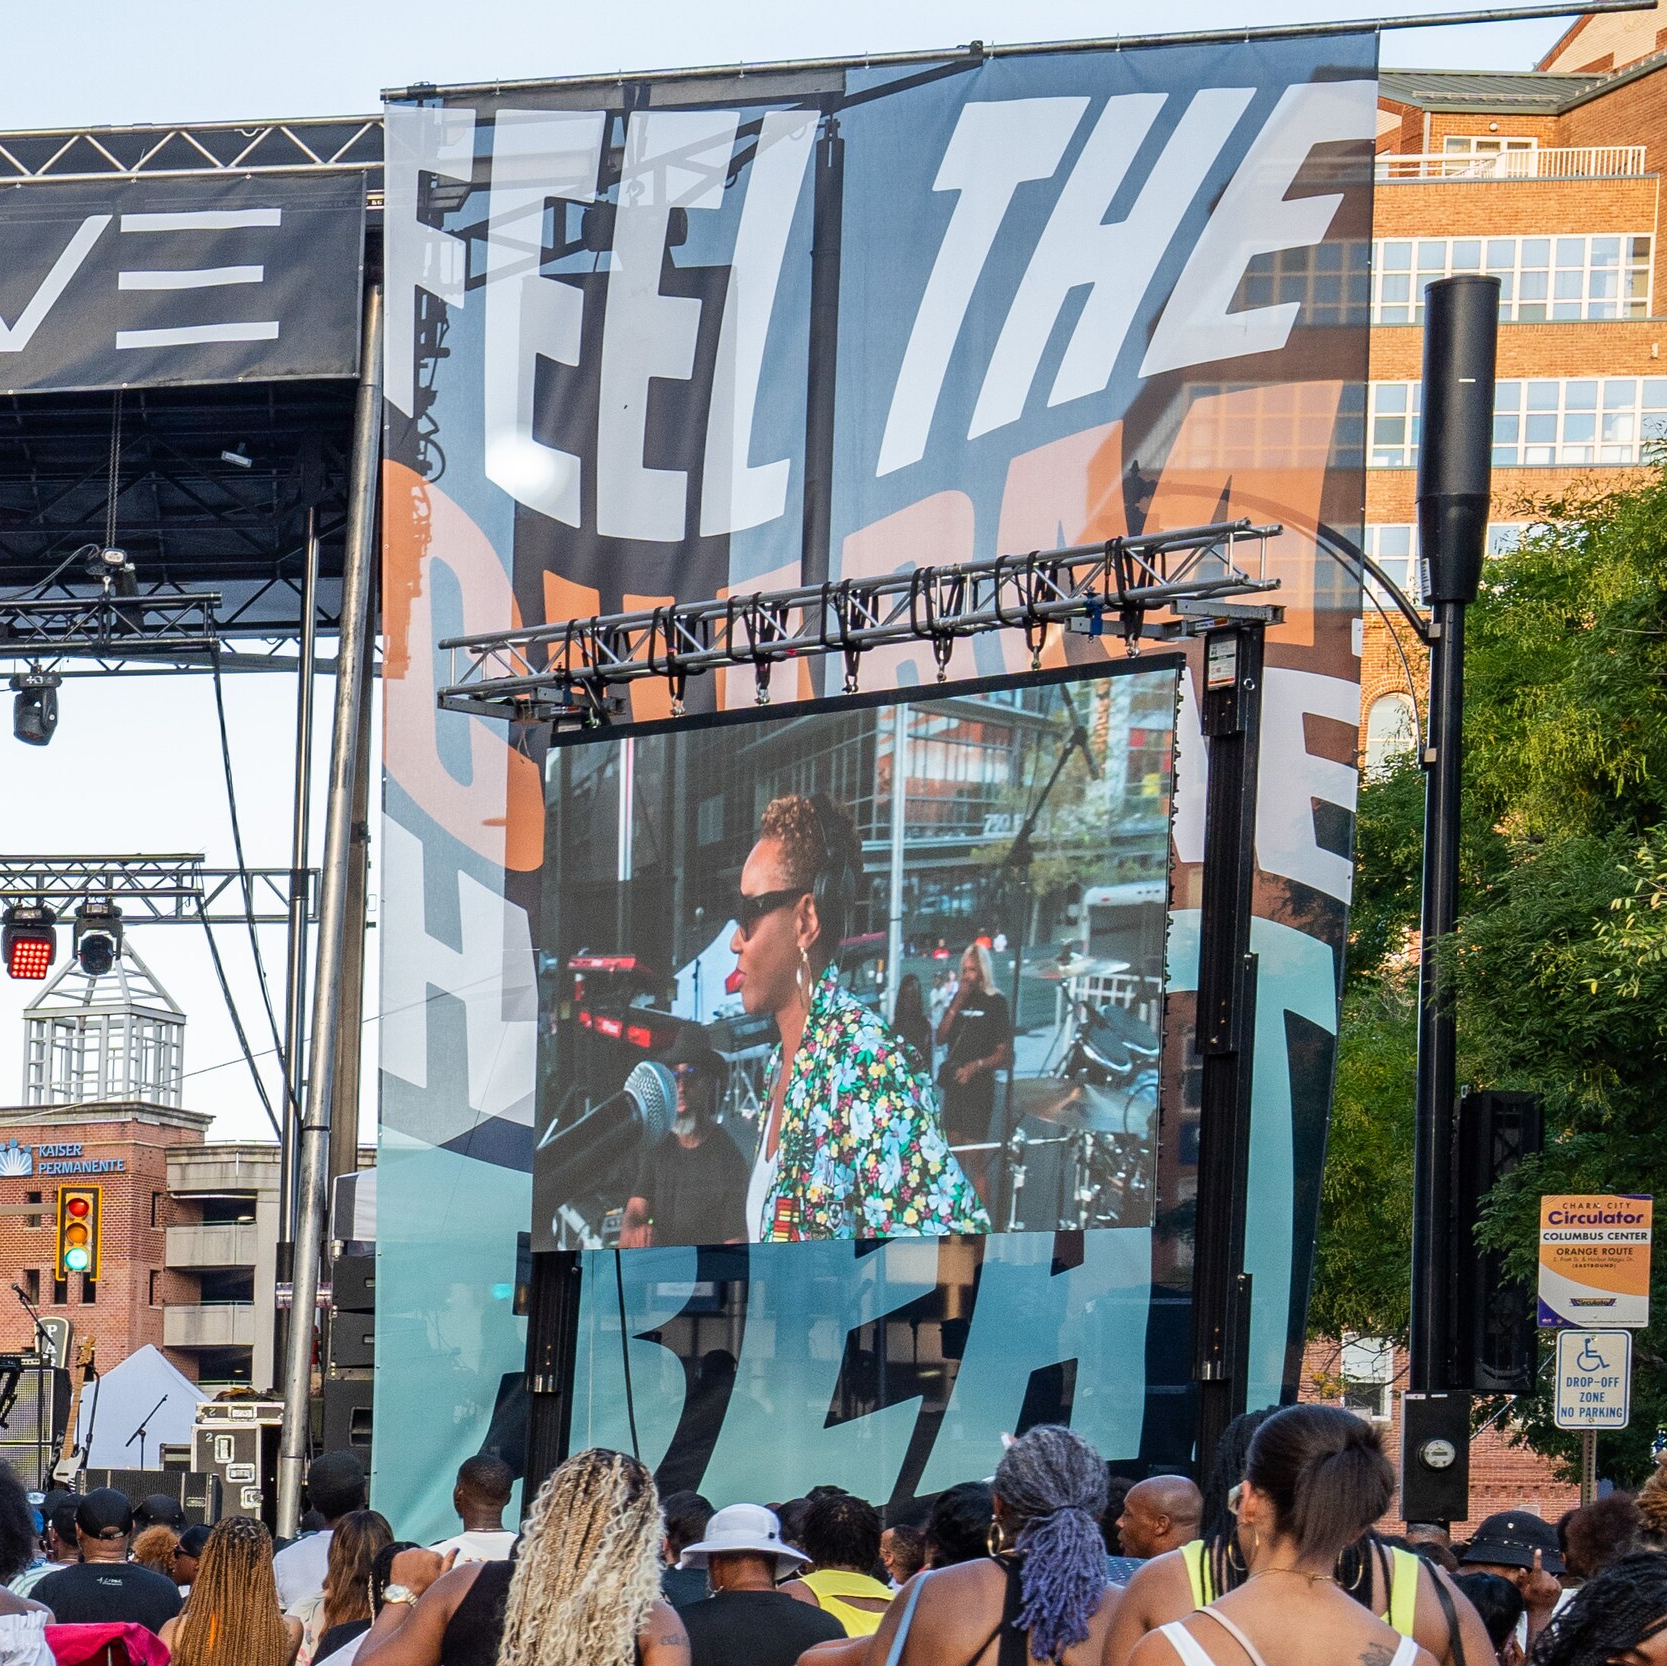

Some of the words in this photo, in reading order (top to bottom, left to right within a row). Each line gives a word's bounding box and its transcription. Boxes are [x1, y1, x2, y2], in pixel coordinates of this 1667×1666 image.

[384, 103, 821, 541] FEEL
[876, 79, 1377, 478] THE
[38, 1142, 83, 1157] KAISER
[38, 1159, 126, 1175] PERMANENTE
[1548, 1210, 1644, 1225] Circulator
[1543, 1232, 1604, 1241] COLUMBUS
[1607, 1232, 1648, 1241] CENTER
[1556, 1248, 1598, 1256] ORANGE
[1602, 1247, 1634, 1255] ROUTE
[1566, 1376, 1620, 1389] DROP-OFF
[1579, 1391, 1606, 1403] ZONE
[1561, 1406, 1576, 1418] NO
[1578, 1405, 1623, 1418] PARKING
